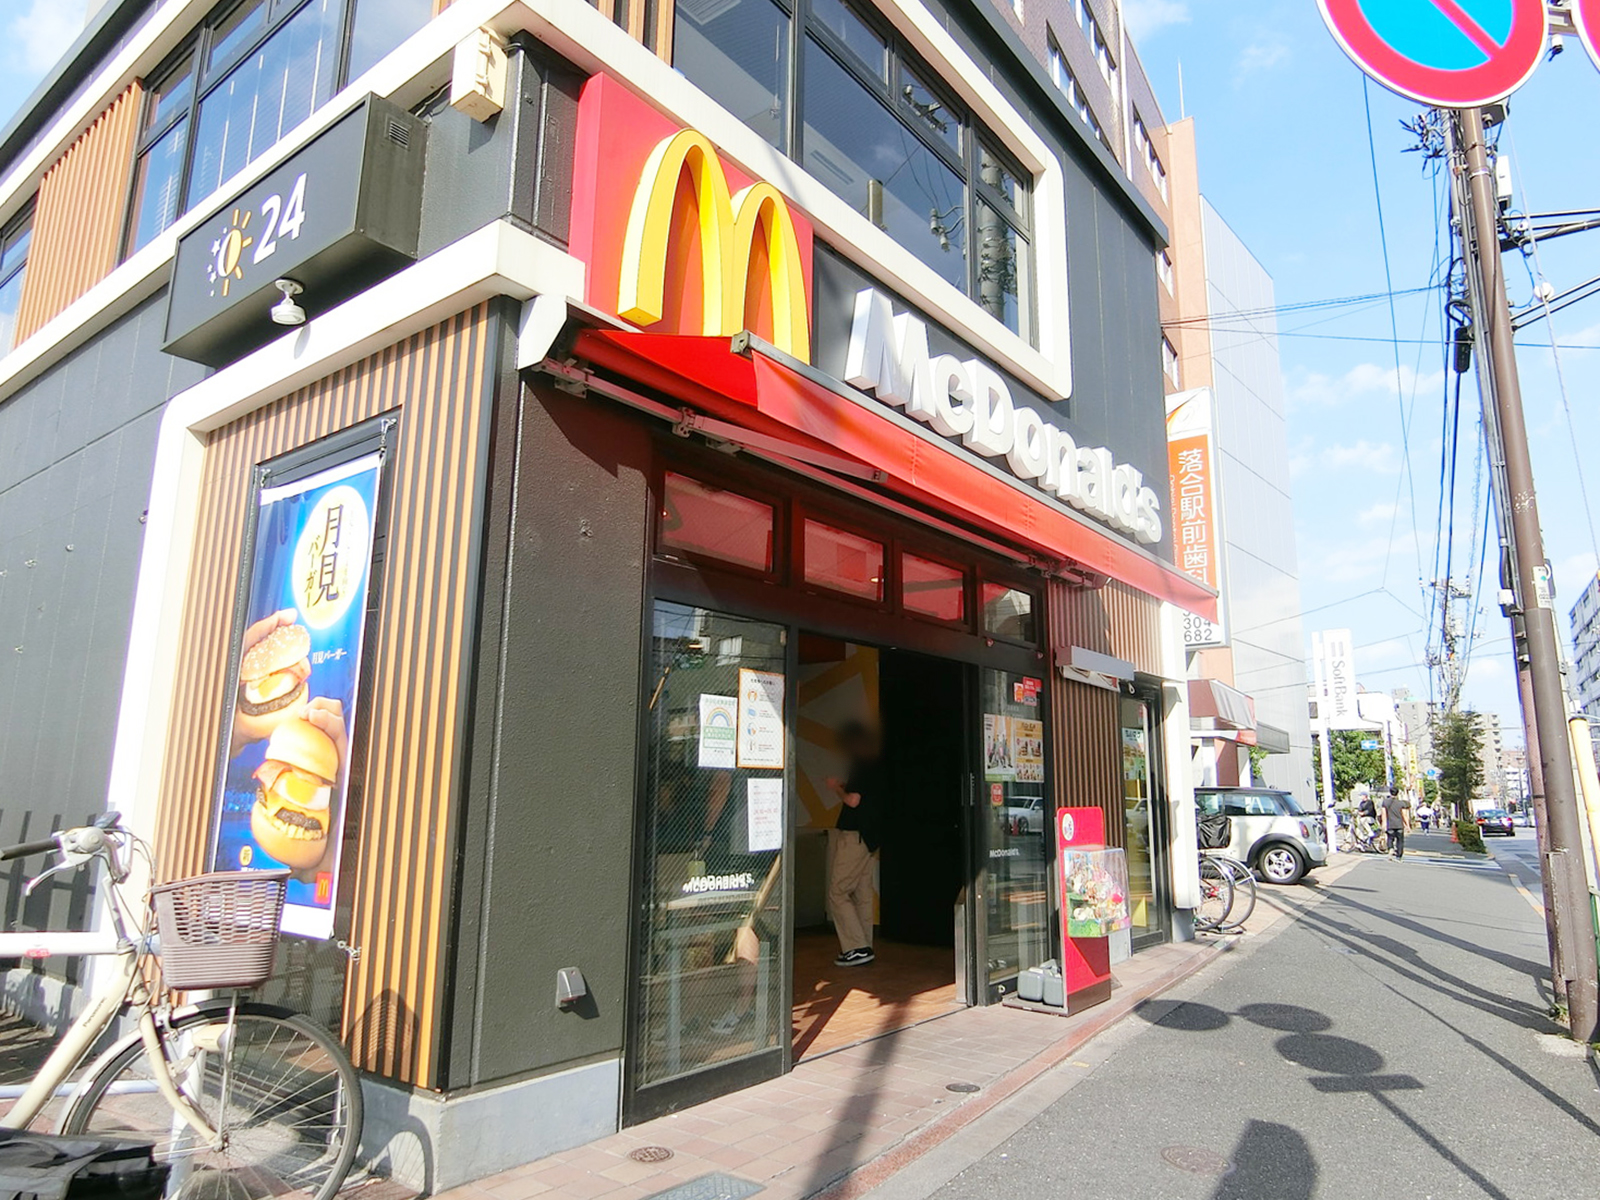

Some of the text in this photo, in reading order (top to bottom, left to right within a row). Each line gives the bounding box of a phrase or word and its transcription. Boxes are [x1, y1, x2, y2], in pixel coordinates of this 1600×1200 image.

[253, 172, 307, 265] 24
[845, 287, 1162, 544] McDonald's
[304, 534, 322, 609] バーガー
[312, 503, 344, 607] 月見
[1184, 628, 1213, 643] 682
[1331, 660, 1348, 717] SoftBank
